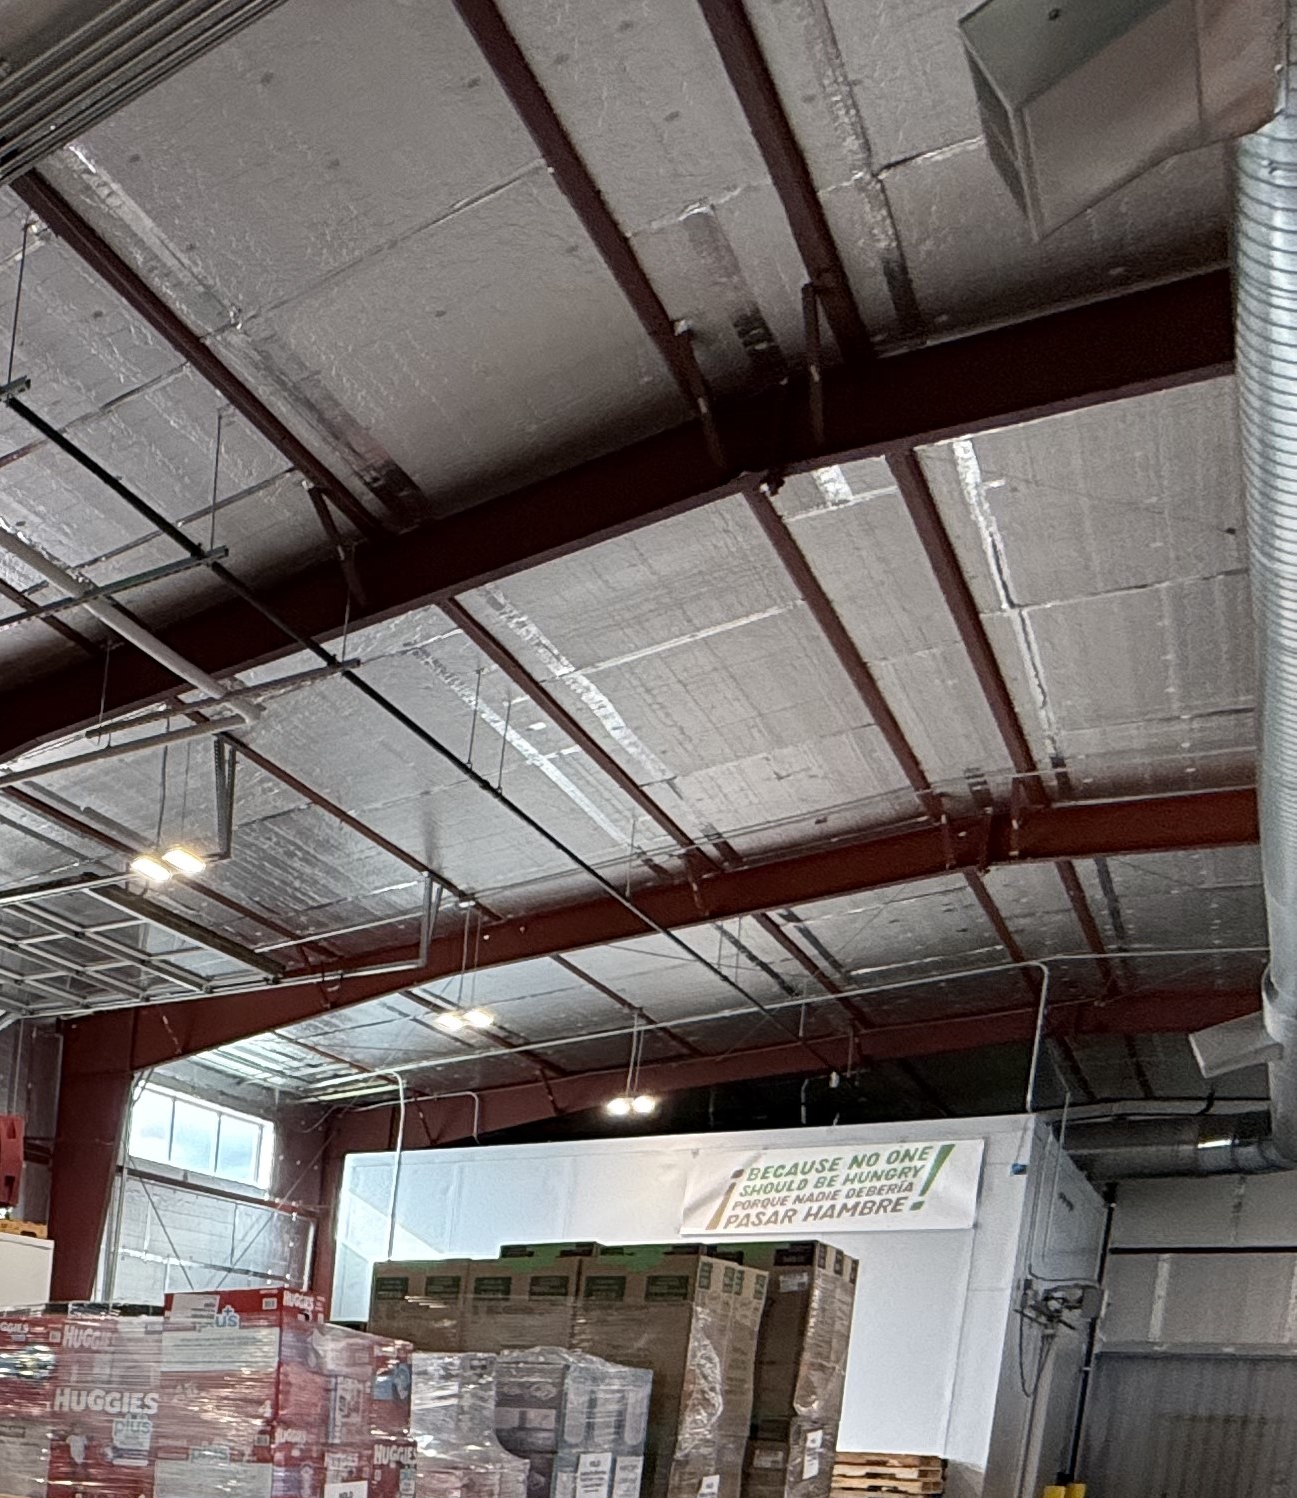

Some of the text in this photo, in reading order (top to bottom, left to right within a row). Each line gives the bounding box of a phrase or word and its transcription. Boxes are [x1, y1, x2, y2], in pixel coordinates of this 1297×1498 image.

[747, 1146, 933, 1181] BECAUSE NO ONE
[739, 1164, 925, 1198] SHOULD BE HUNGRY
[724, 1196, 908, 1230] PASAR HAMBRE
[731, 1195, 789, 1212] PORQUE
[792, 1189, 840, 1205] NADIE
[54, 1387, 159, 1415] HUGGIES
[113, 1417, 152, 1437] plus
